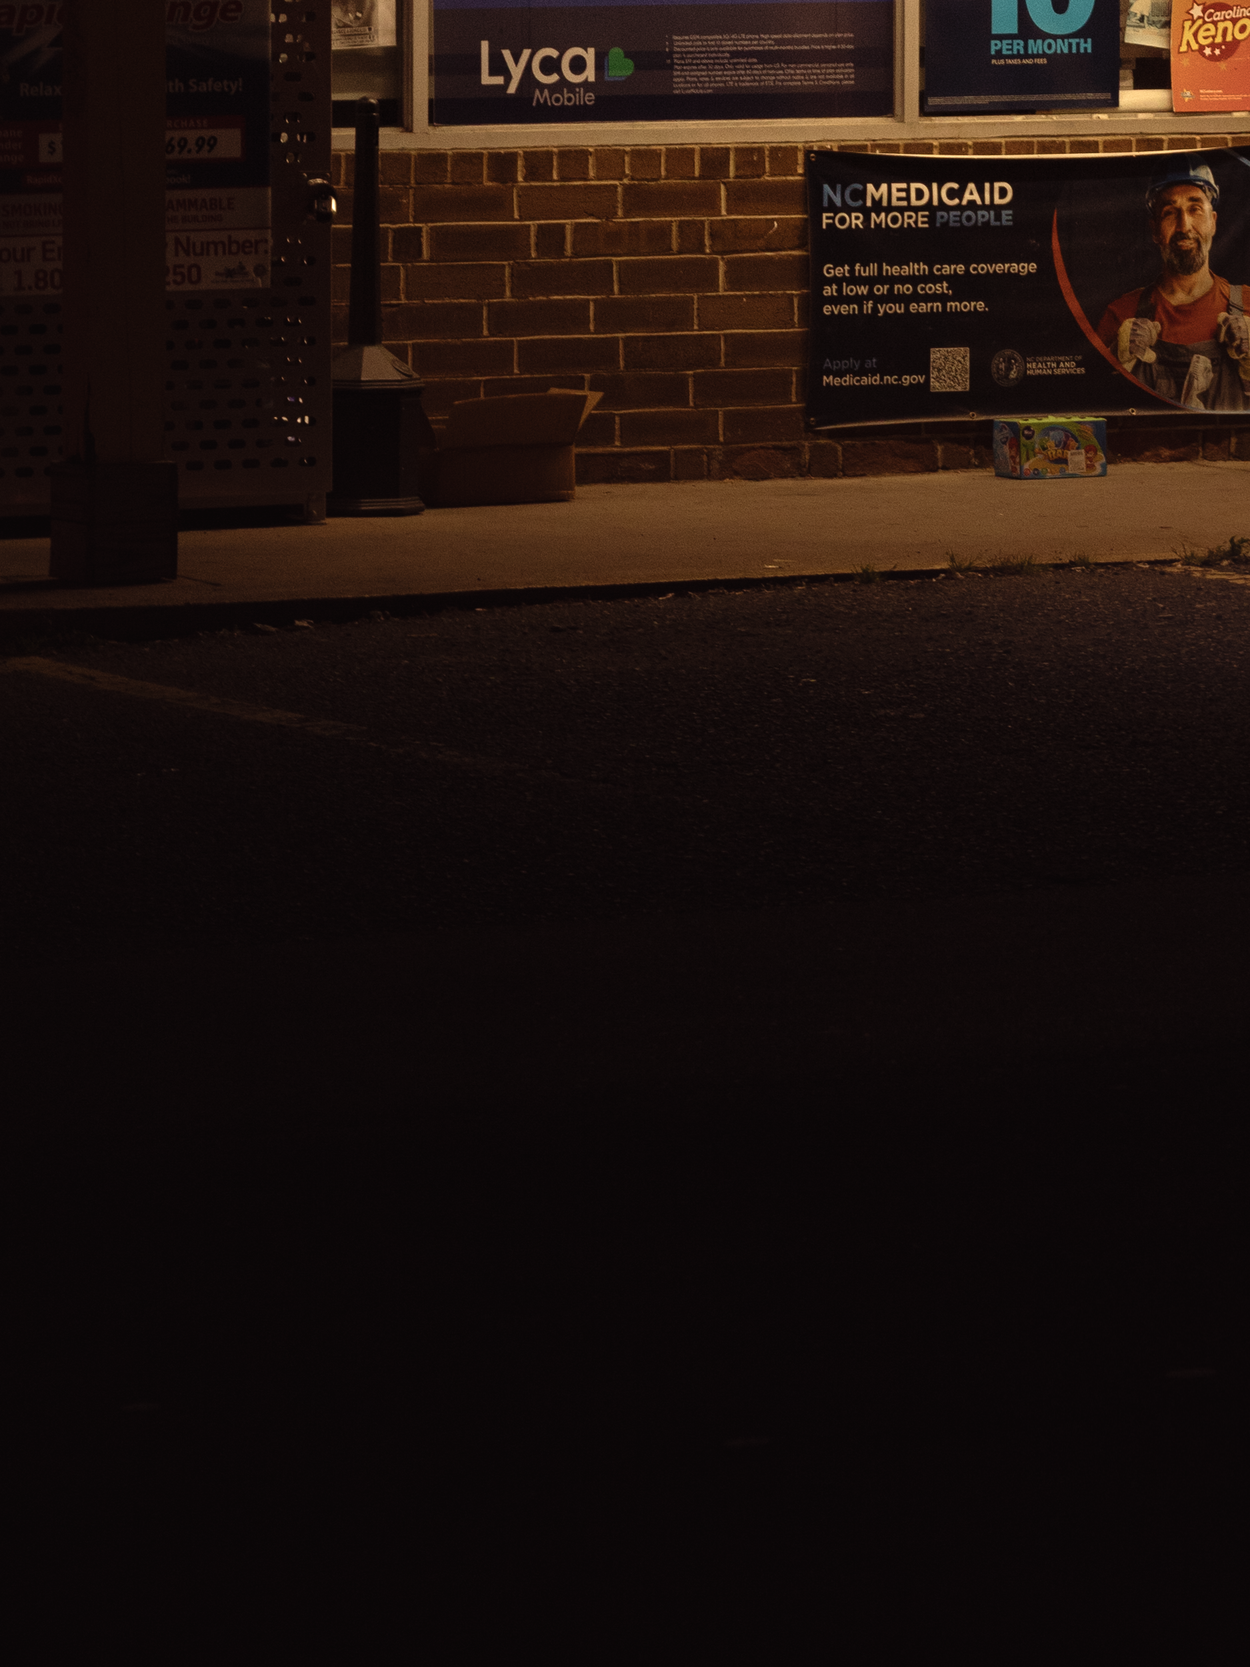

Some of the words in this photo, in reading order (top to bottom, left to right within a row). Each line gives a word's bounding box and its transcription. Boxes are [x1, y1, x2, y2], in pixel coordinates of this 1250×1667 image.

[990, 39, 1024, 55] PER
[1027, 38, 1092, 54] MONTH
[480, 40, 596, 94] Lyca
[188, 77, 243, 95] Safety!
[532, 88, 596, 108] Mobile
[822, 212, 864, 229] FOR
[870, 211, 930, 228] MORE
[935, 210, 1014, 227] PEOPLE
[174, 235, 268, 257] Number:
[823, 264, 850, 278] Get
[854, 262, 878, 277] full
[882, 262, 929, 276] health
[933, 264, 966, 276] care
[969, 263, 1038, 277] coverage
[823, 284, 838, 297] at
[842, 282, 869, 296] low
[873, 285, 890, 296] or
[894, 284, 914, 295] no
[917, 281, 953, 296] cost,
[823, 302, 858, 315] even
[863, 300, 873, 314] if
[877, 303, 904, 317] you
[909, 301, 943, 313] earn
[946, 300, 989, 313] more.
[822, 358, 861, 372] Apply
[864, 357, 878, 369] at
[1026, 368, 1052, 376] HUMAN
[1053, 367, 1086, 375] SERVICES
[822, 372, 926, 387] Medicaid.nc.gov
